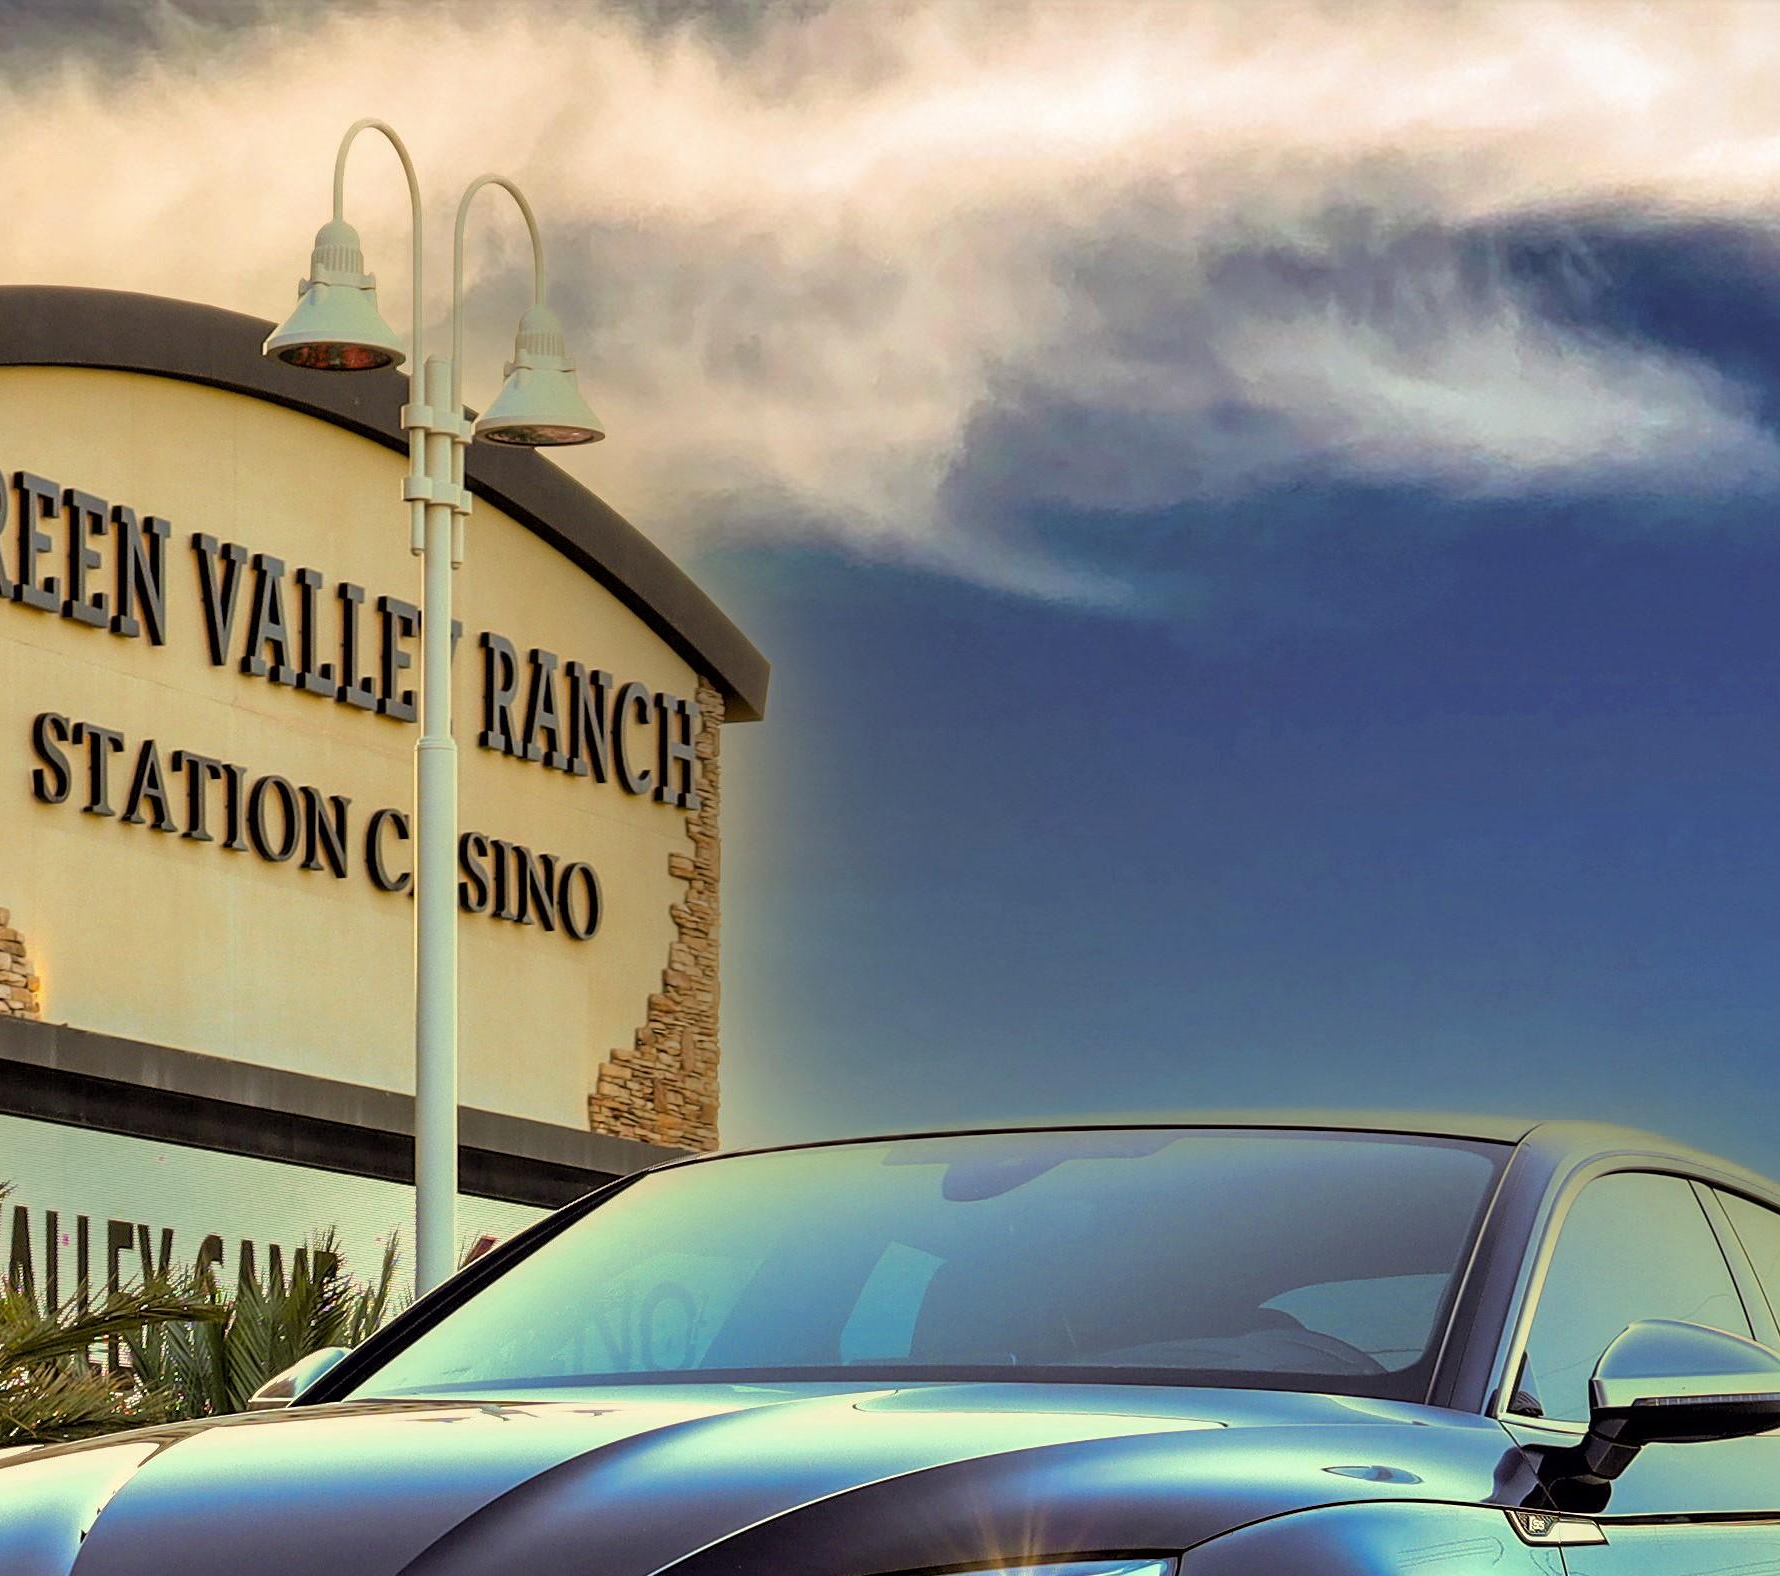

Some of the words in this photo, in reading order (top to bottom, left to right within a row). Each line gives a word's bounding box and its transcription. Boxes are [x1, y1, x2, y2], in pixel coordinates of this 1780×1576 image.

[191, 532, 462, 736] VALLE
[479, 631, 702, 811] RANCH
[32, 711, 351, 879] STATION
[365, 808, 603, 942] CSINO
